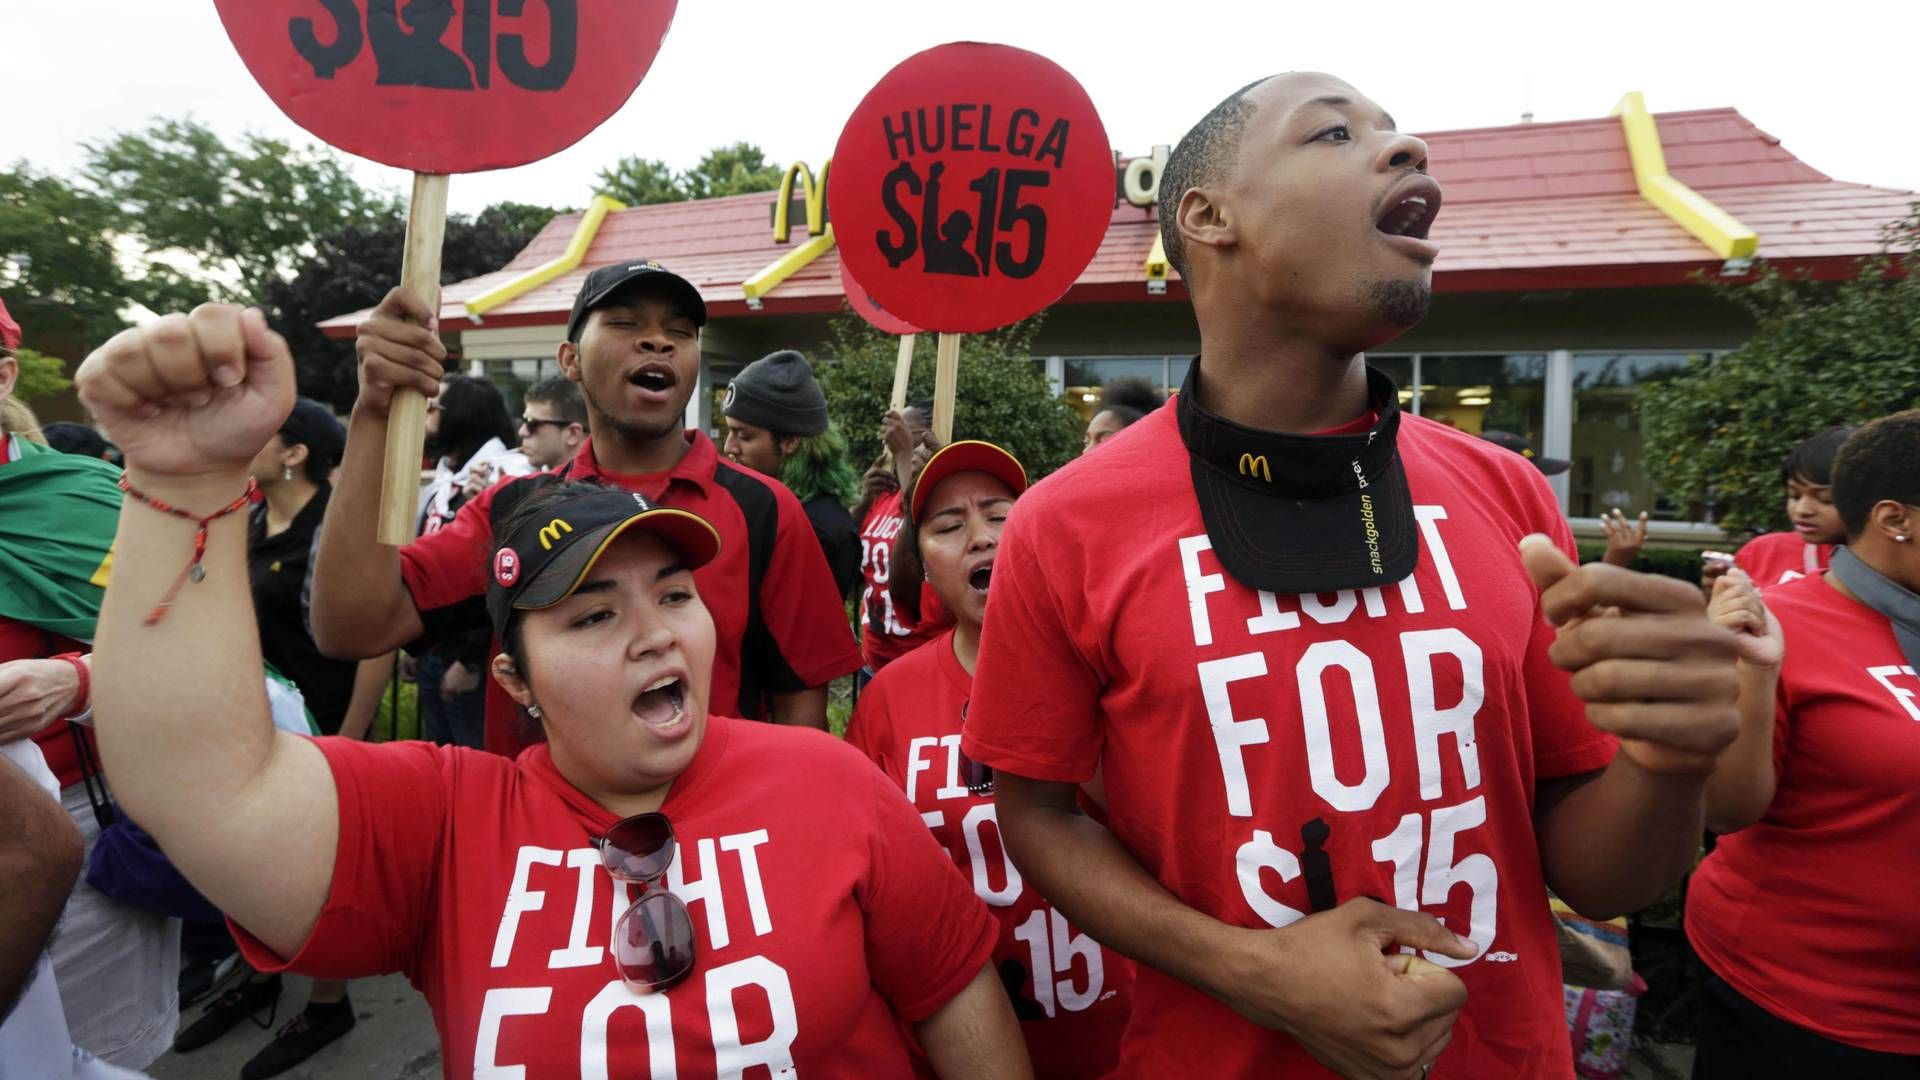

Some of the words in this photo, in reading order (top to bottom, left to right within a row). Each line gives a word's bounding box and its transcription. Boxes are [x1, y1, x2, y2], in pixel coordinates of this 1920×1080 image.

[882, 103, 1071, 169] HUELGA
[875, 160, 1051, 279] $15
[1197, 627, 1485, 817] FOR
[473, 954, 799, 1080] FOR
